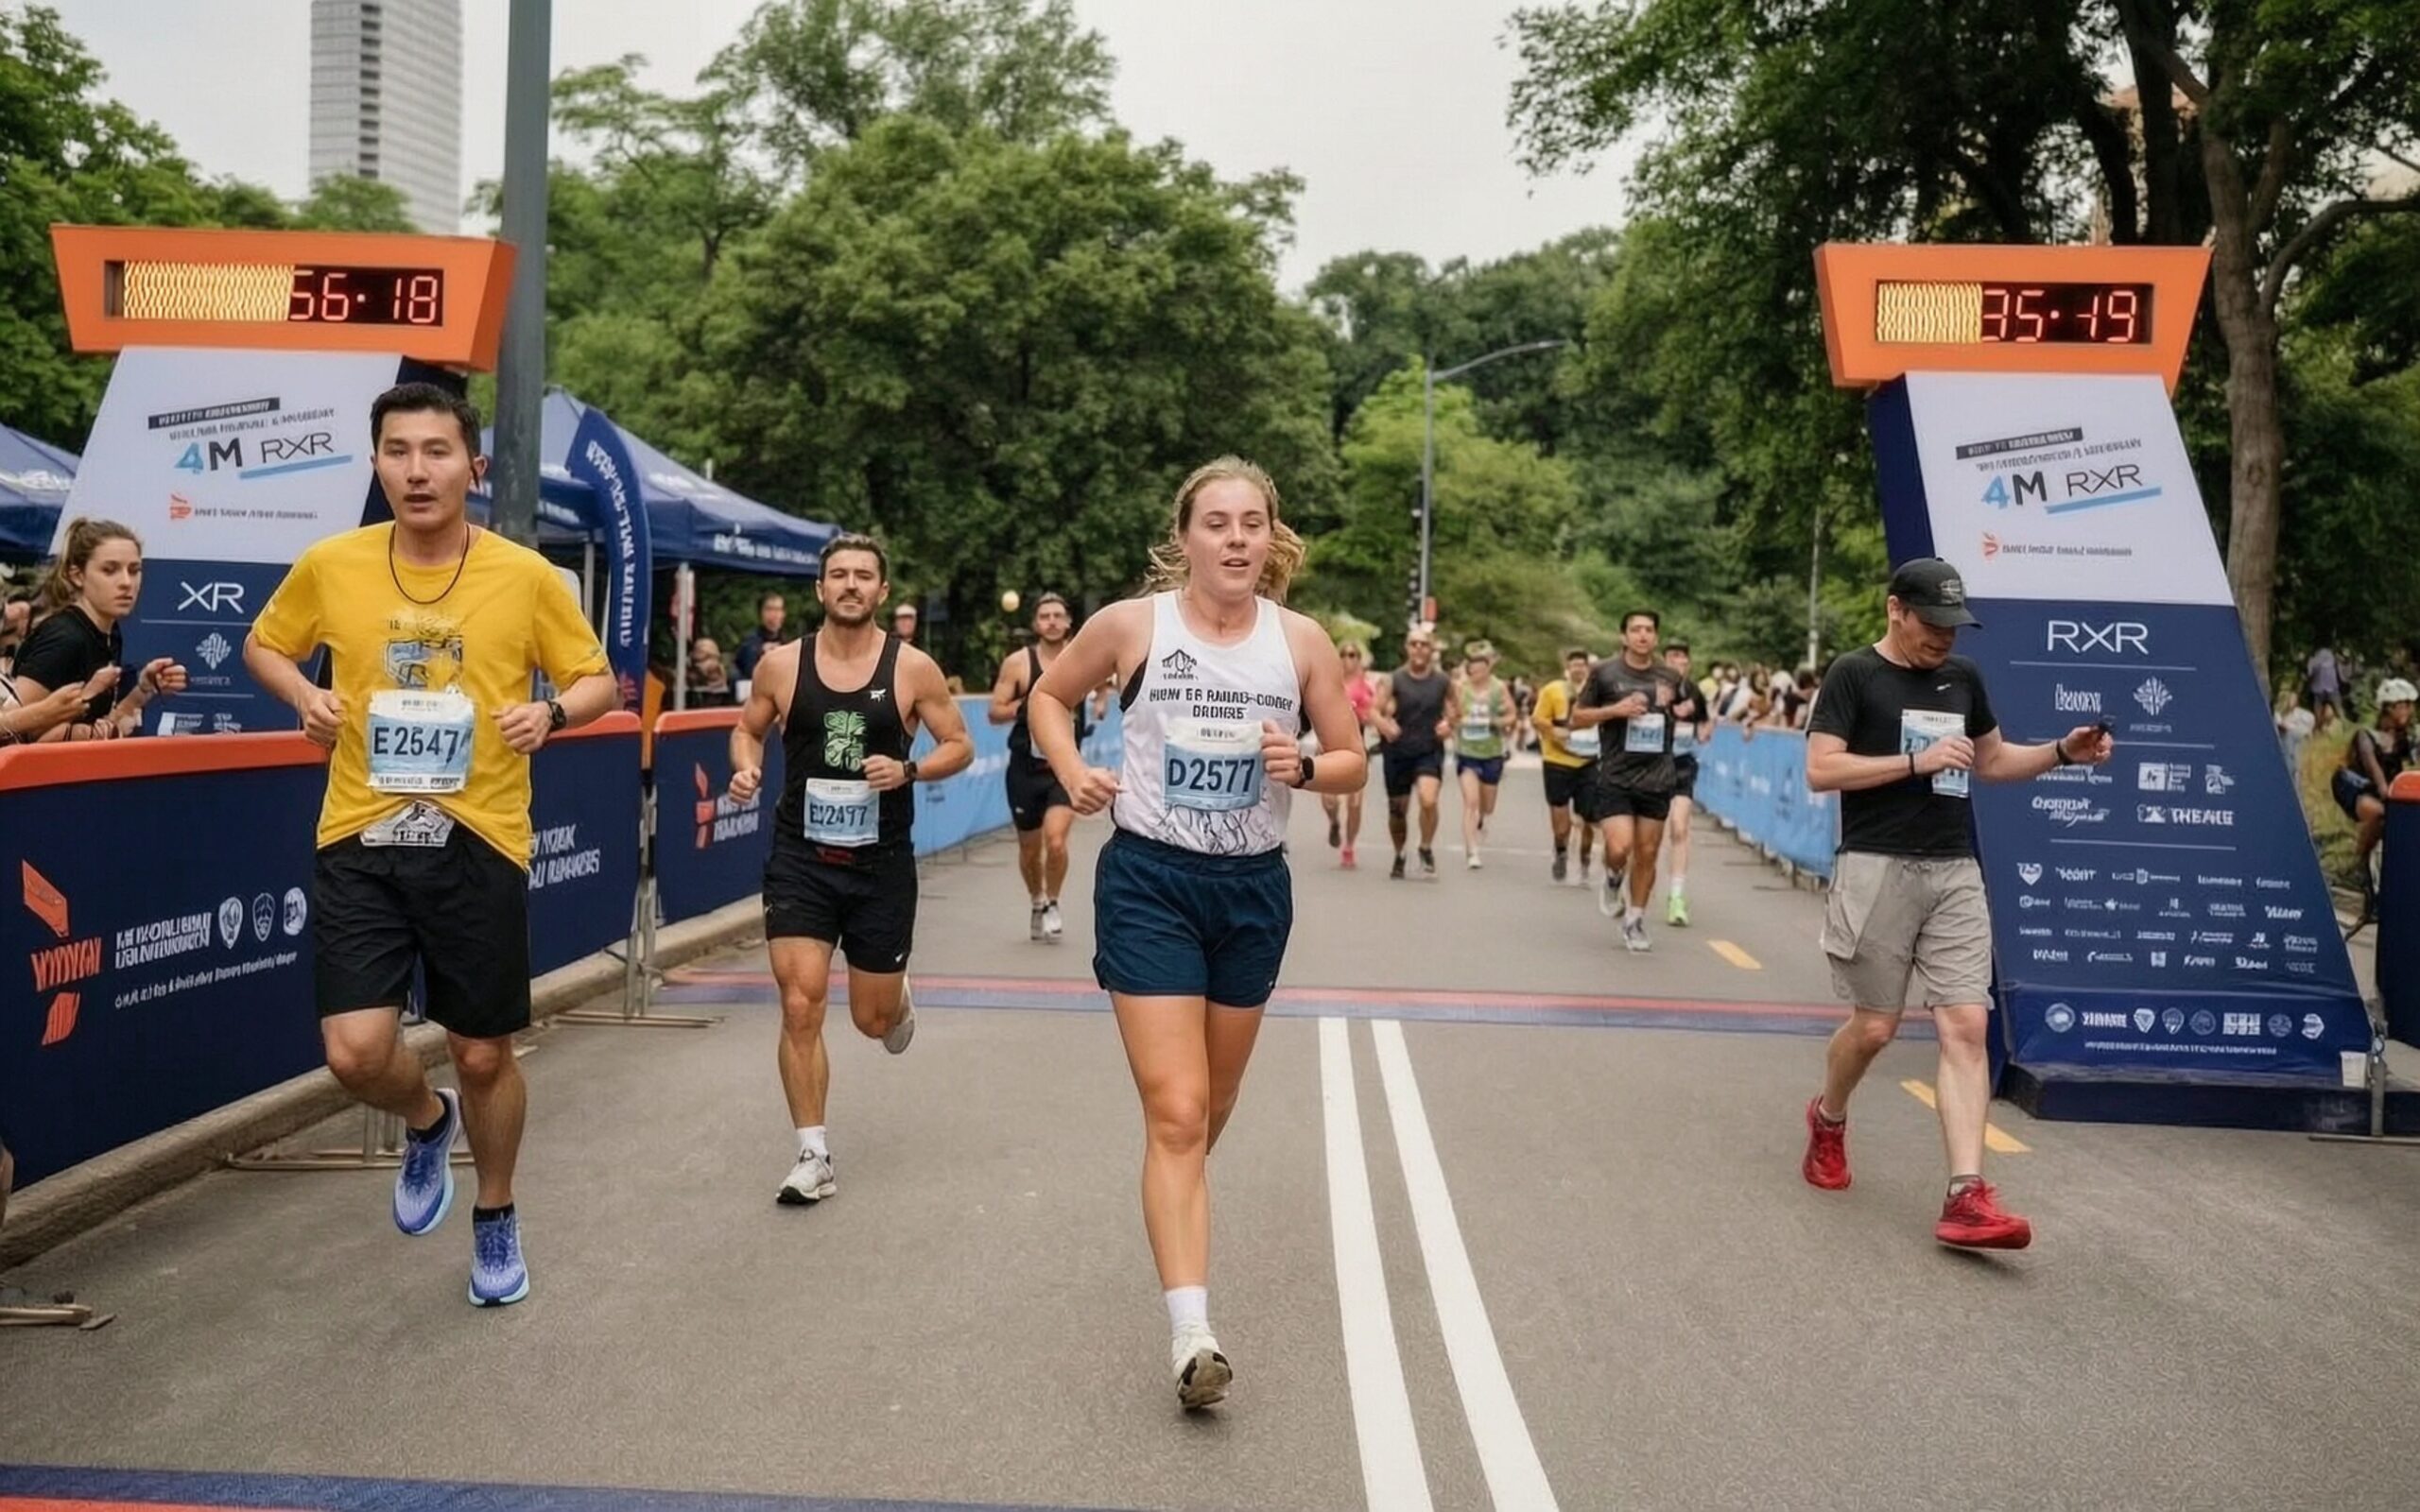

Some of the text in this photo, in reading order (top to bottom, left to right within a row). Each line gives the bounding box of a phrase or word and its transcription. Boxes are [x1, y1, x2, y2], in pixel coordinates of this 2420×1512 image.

[260, 431, 335, 464] RXR
[2066, 463, 2144, 497] RXR
[177, 580, 245, 614] XR
[2047, 619, 2150, 655] RXR
[1167, 757, 1255, 794] D2577
